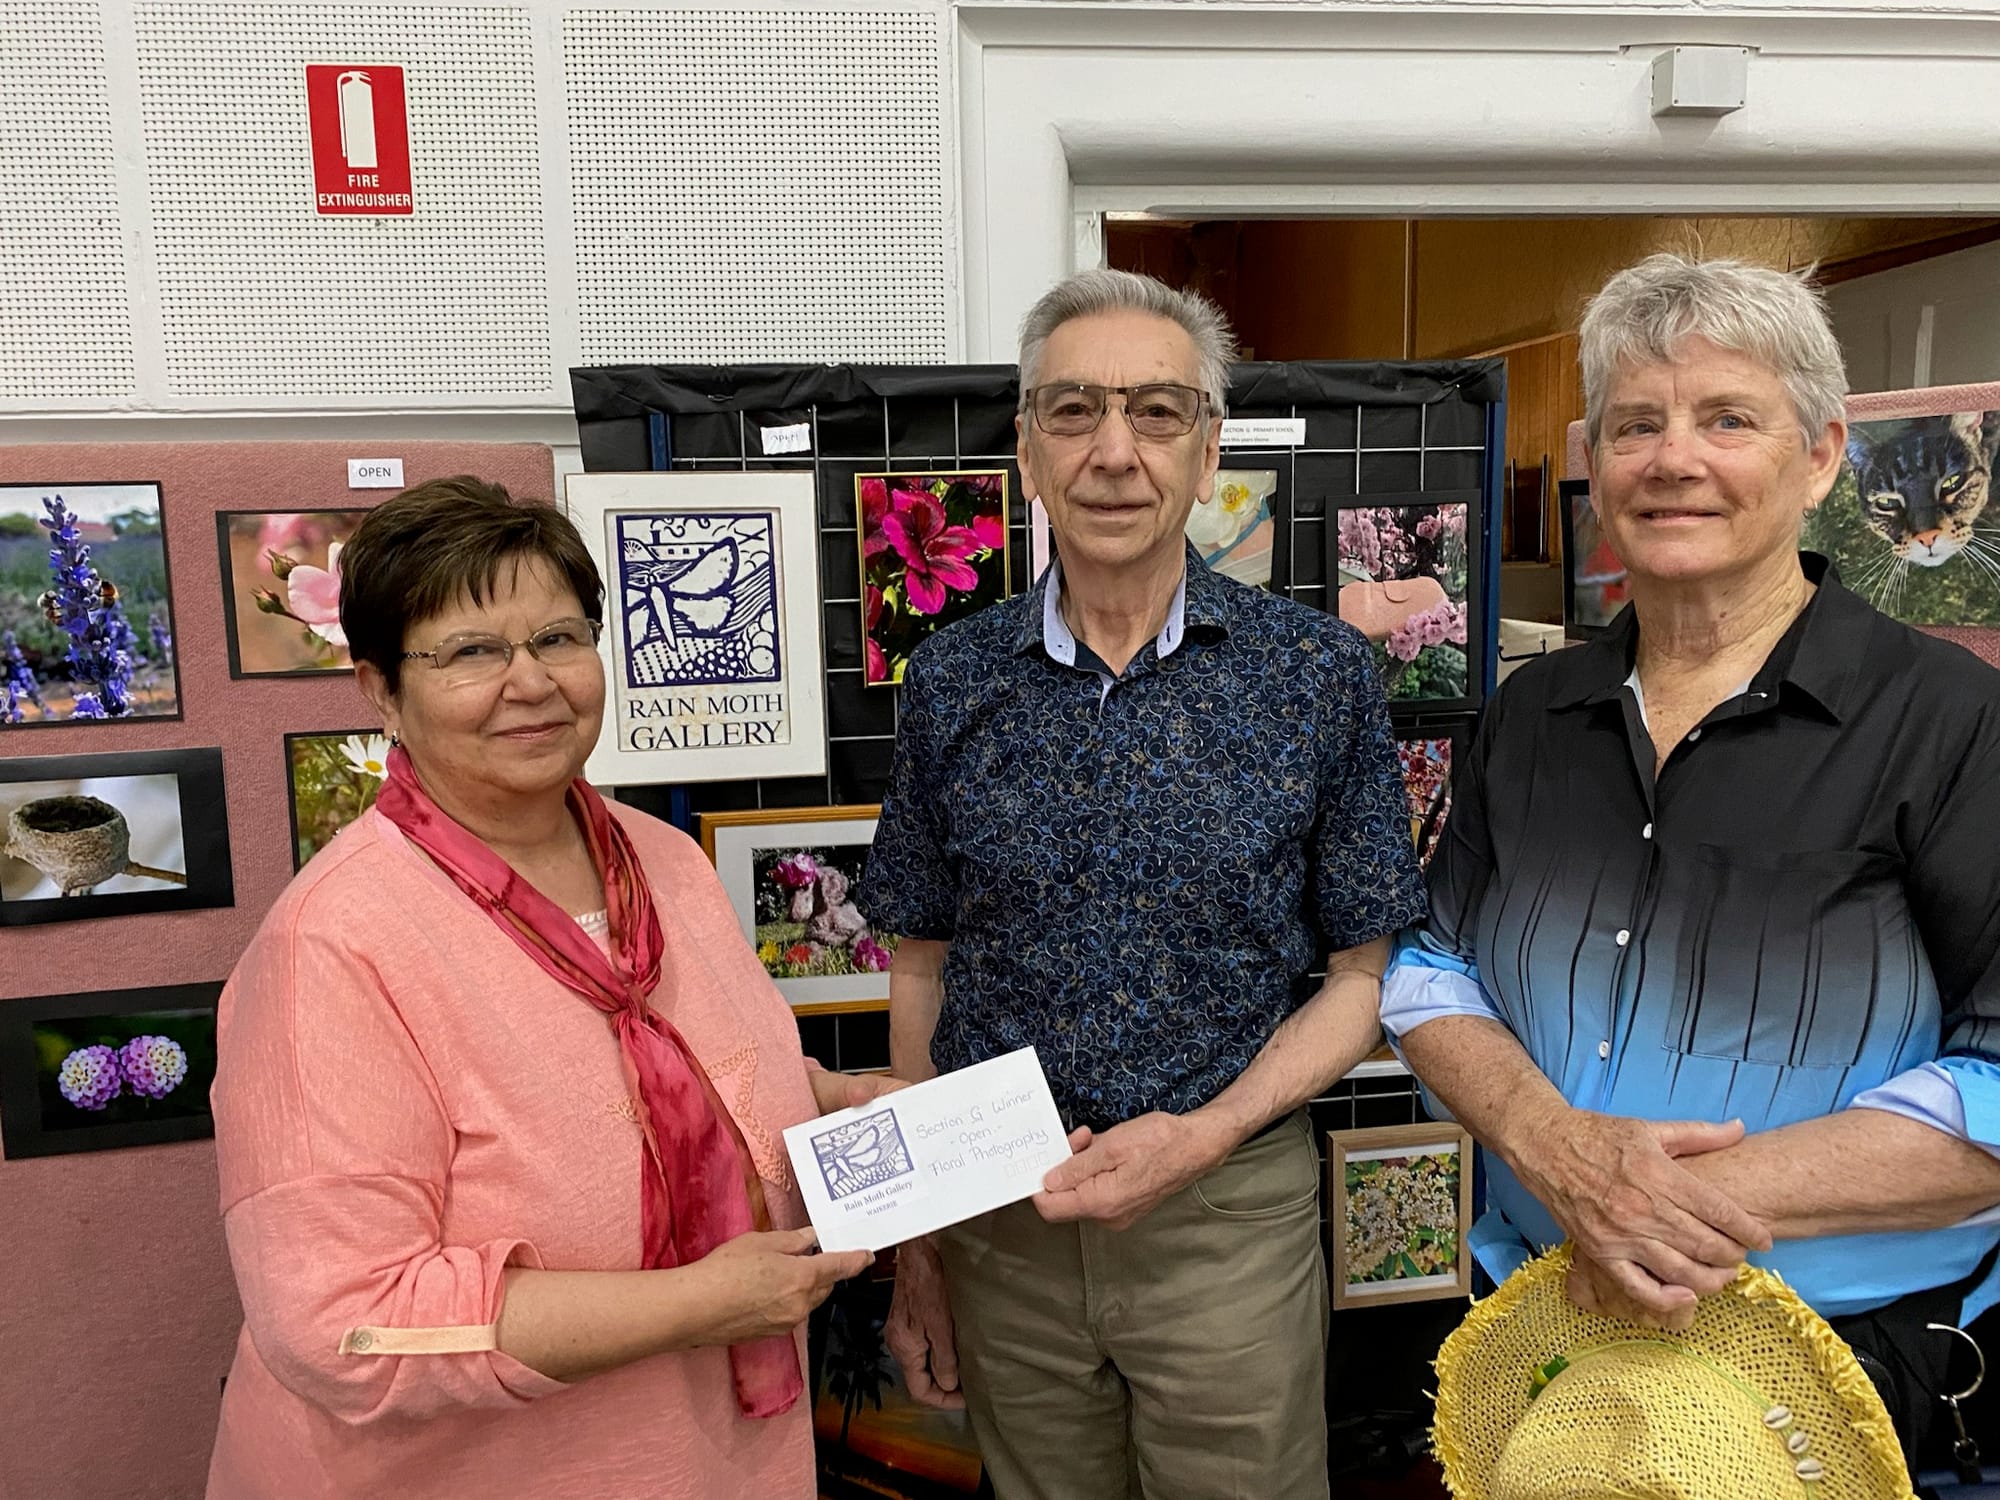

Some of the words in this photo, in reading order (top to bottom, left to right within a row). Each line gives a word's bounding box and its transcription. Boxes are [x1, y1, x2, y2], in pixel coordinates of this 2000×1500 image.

[348, 174, 380, 188] FIRE
[318, 193, 411, 207] EXTINGUISHER
[358, 466, 392, 478] OPEN
[627, 697, 697, 719] RAIN
[707, 693, 784, 716] MOTH
[630, 720, 784, 750] GALLERY
[915, 1114, 964, 1140] Section
[969, 1104, 984, 1124] G
[991, 1089, 1036, 1115] Winner
[958, 1126, 993, 1146] Open
[928, 1154, 966, 1177] Floral
[968, 1128, 1050, 1161] Photography
[843, 1199, 864, 1213] Rain
[863, 1190, 886, 1206] Moth
[885, 1179, 914, 1197] Gallery
[865, 1200, 899, 1217] WAIKERIE
